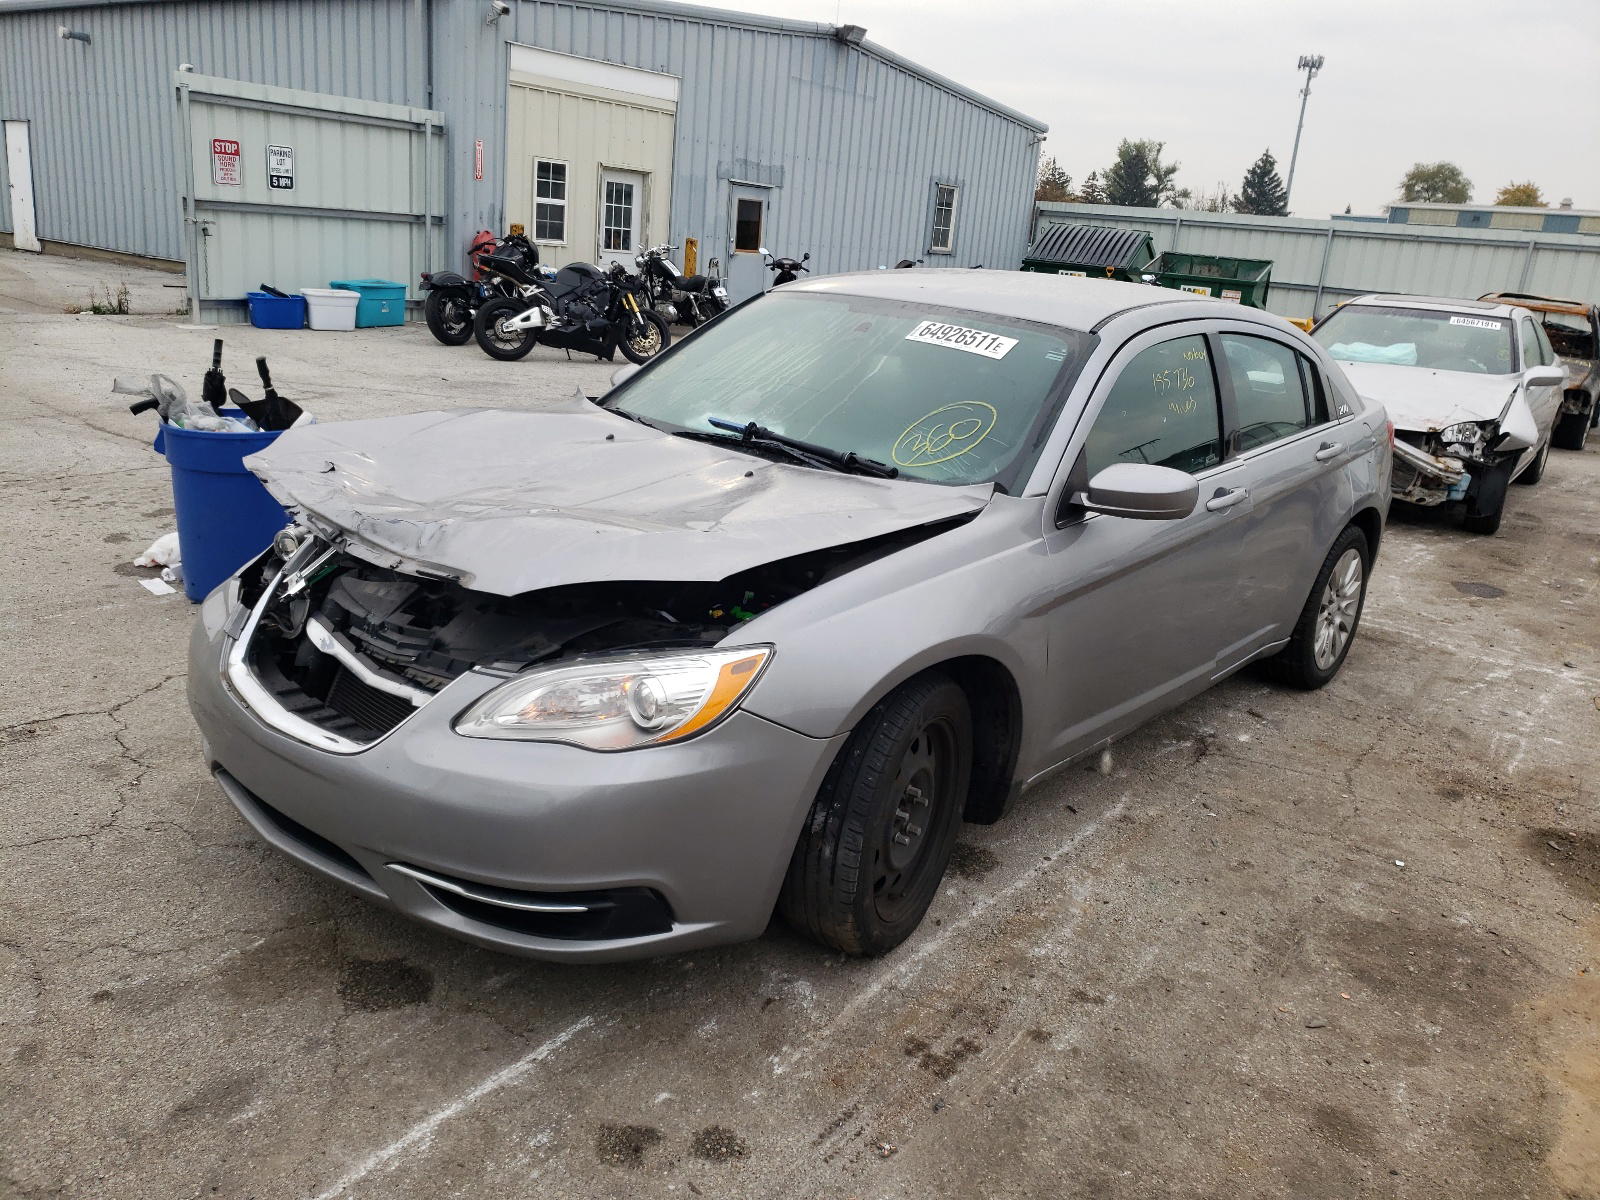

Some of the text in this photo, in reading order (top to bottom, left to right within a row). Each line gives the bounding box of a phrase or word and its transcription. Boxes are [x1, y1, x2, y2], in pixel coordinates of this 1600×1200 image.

[214, 142, 238, 154] STOP
[270, 149, 292, 159] PARKING
[272, 176, 291, 187] 5 MPH
